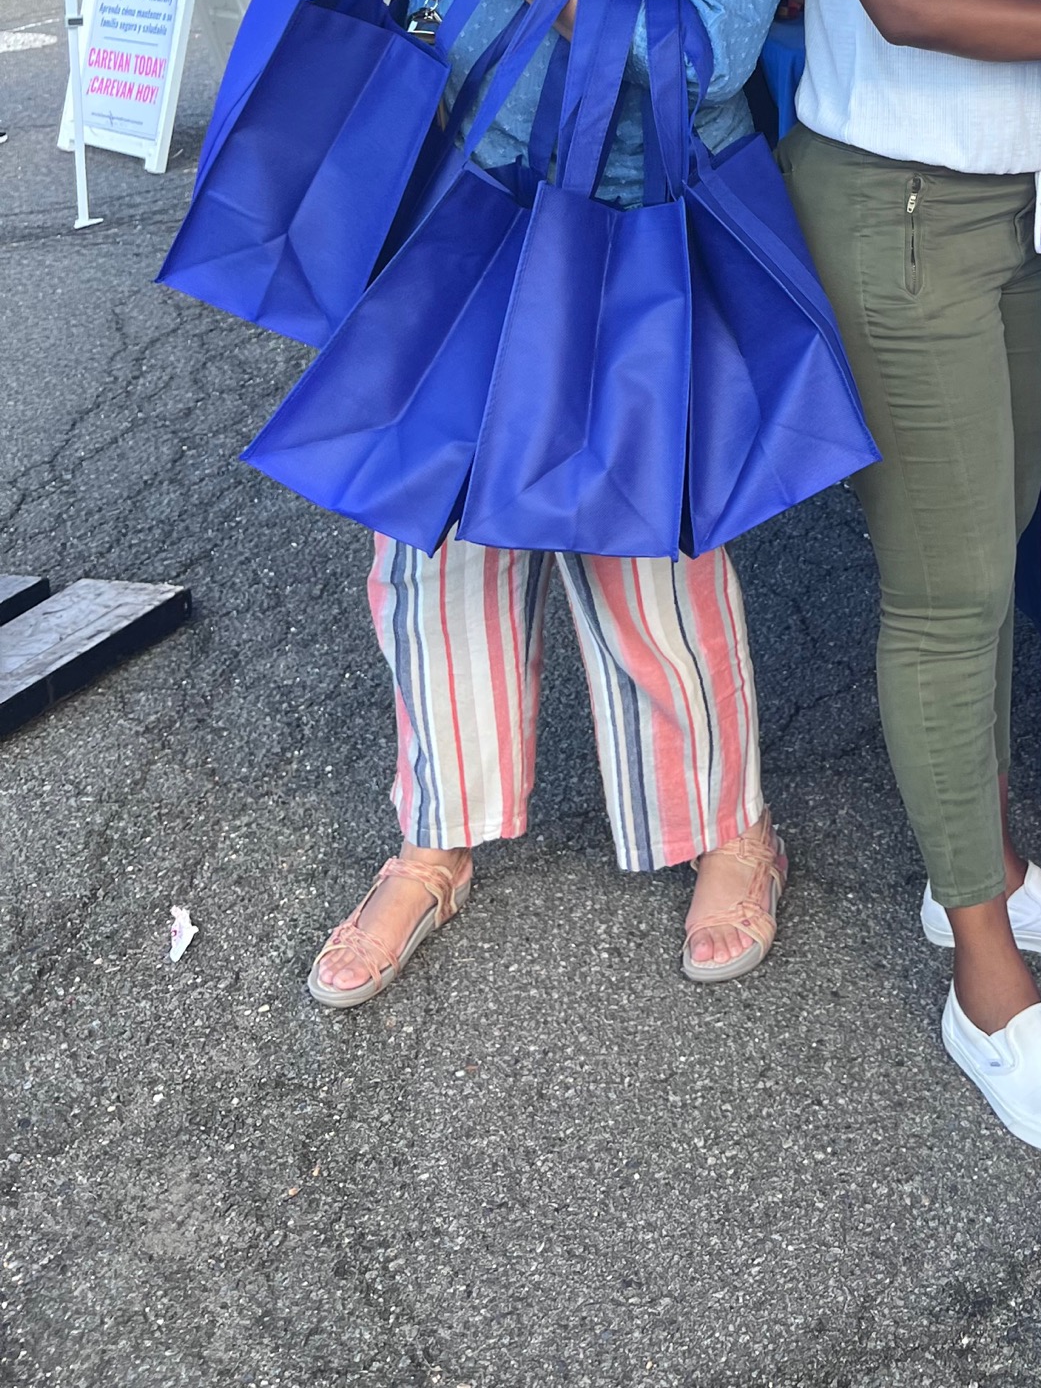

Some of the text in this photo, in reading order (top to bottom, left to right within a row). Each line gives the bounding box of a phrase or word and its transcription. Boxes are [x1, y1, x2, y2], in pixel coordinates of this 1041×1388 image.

[88, 47, 166, 79] CAREVAN TODAY!
[134, 83, 159, 105] HOY!
